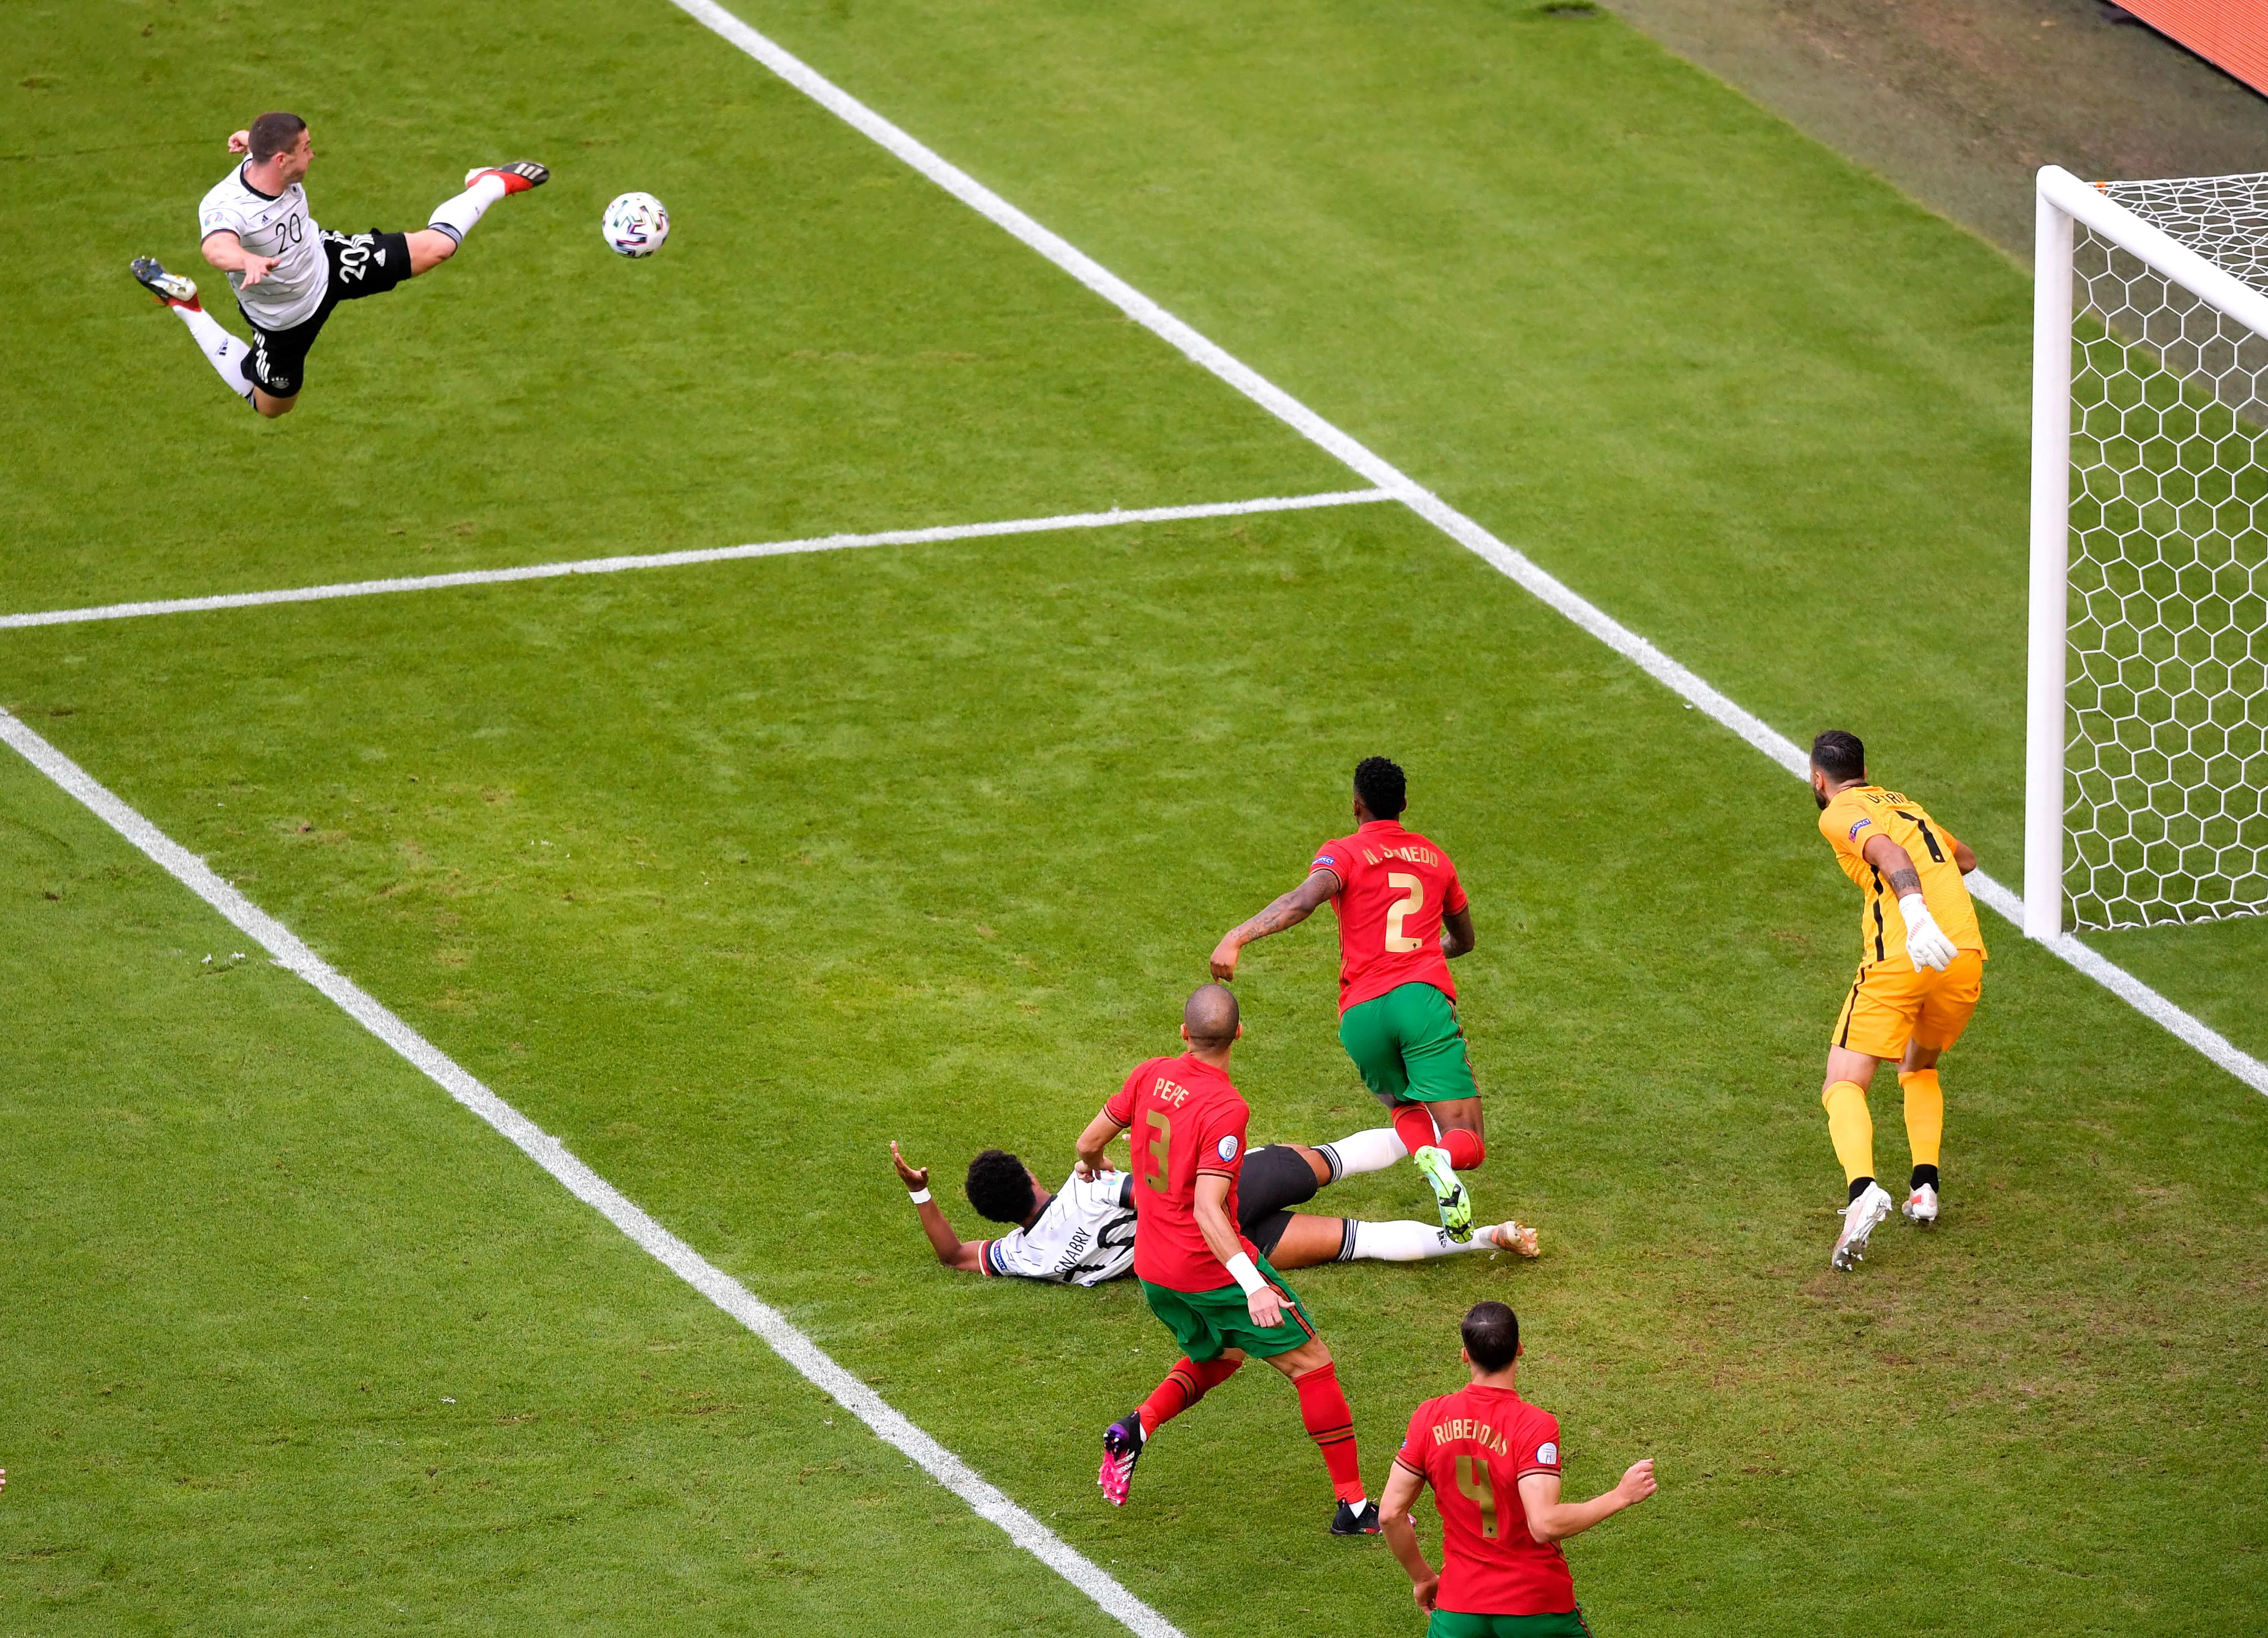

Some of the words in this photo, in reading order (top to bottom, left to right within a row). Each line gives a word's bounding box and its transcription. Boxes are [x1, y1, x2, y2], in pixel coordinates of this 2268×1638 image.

[275, 213, 302, 254] 20
[339, 246, 370, 283] 20
[1894, 810, 1946, 863] 1
[1385, 872, 1424, 953] 2
[1153, 1078, 1189, 1108] PEPE
[1145, 1109, 1170, 1193] 3
[1054, 1227, 1091, 1274] GNABRY
[1455, 1455, 1498, 1539] 4
